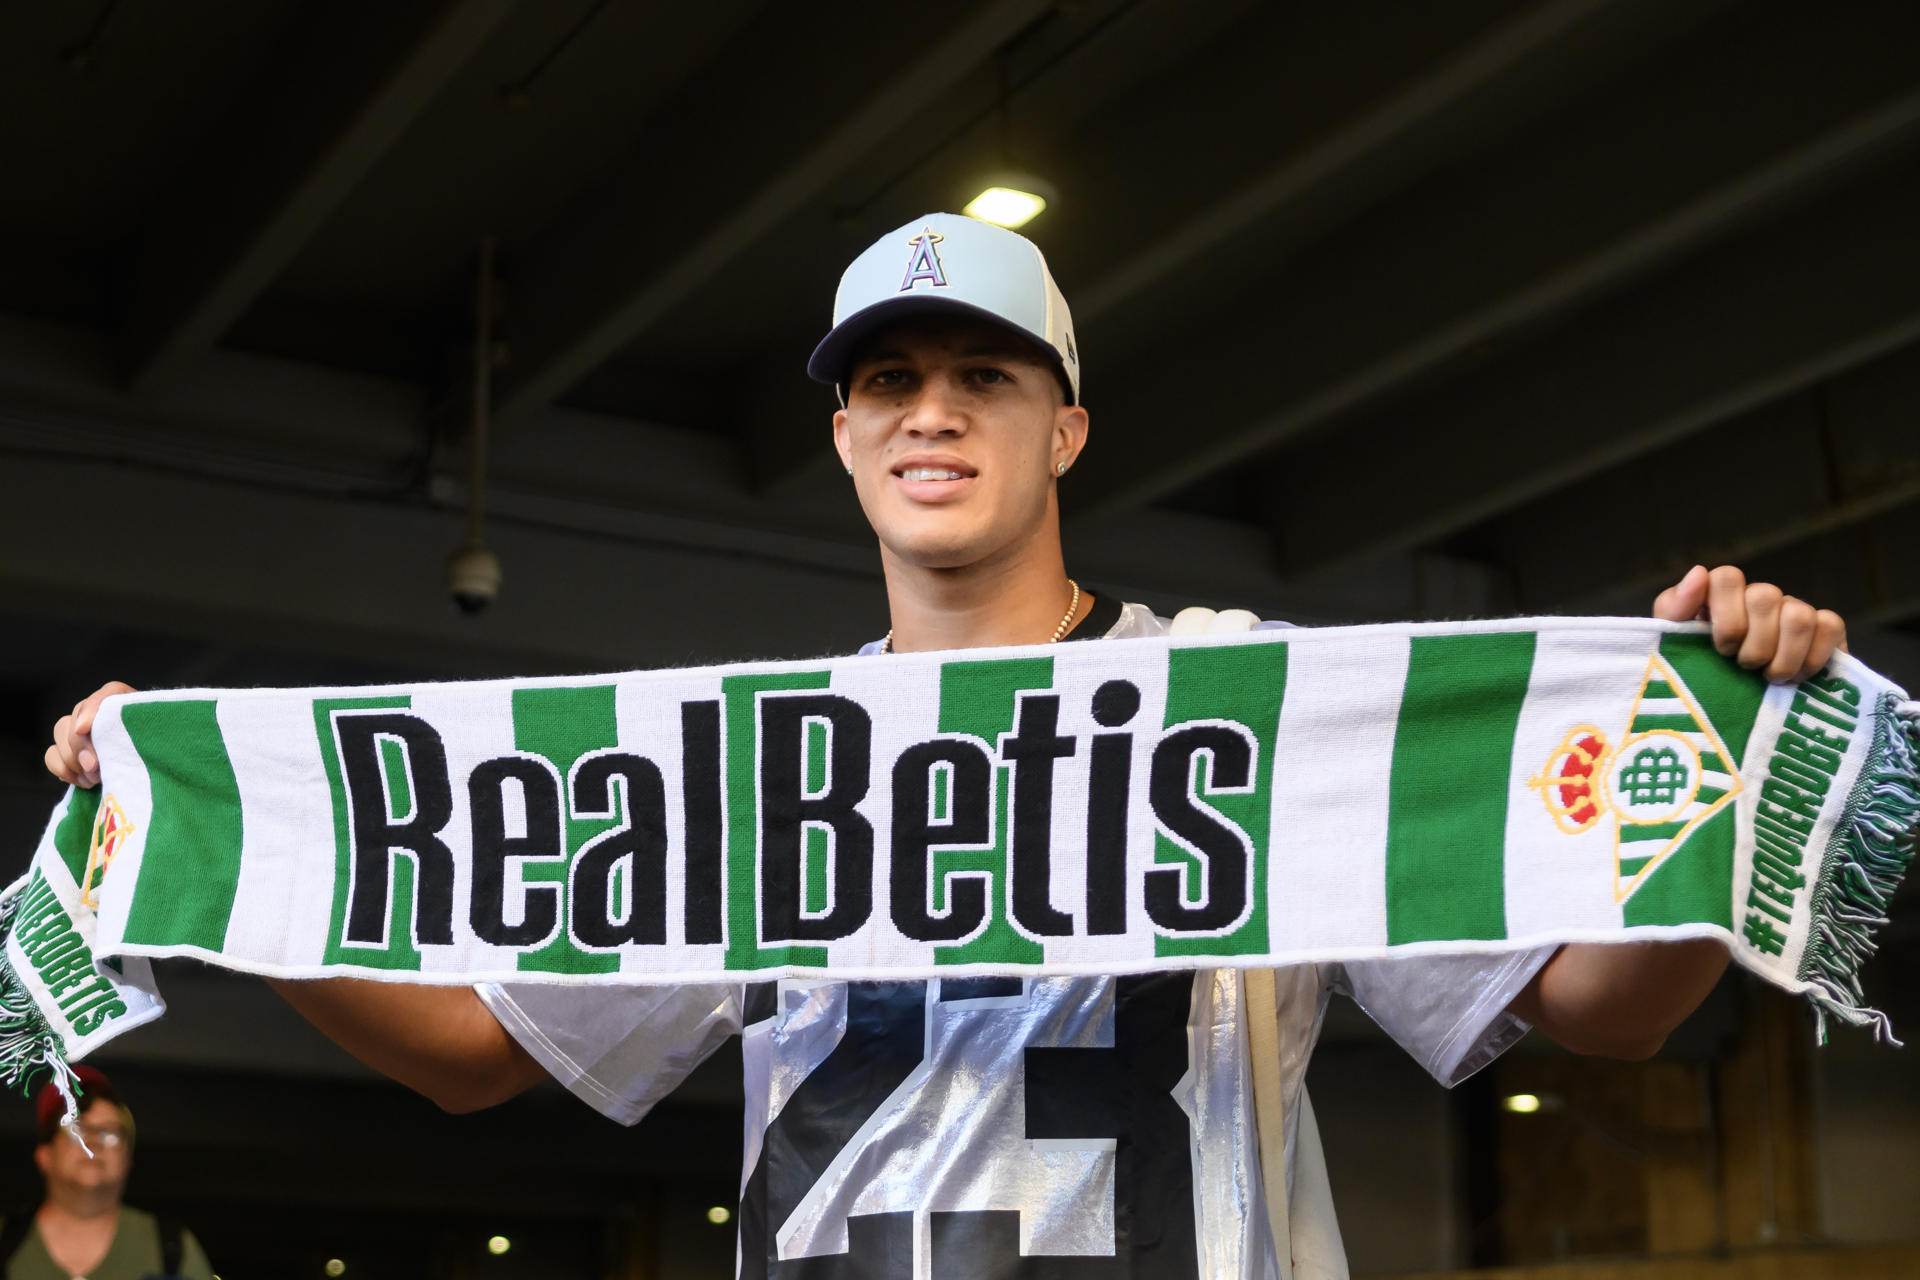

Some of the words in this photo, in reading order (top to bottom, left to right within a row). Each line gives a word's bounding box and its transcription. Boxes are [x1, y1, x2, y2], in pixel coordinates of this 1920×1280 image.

[899, 225, 949, 292] A
[335, 699, 723, 948] Real
[760, 678, 1257, 943] Betis
